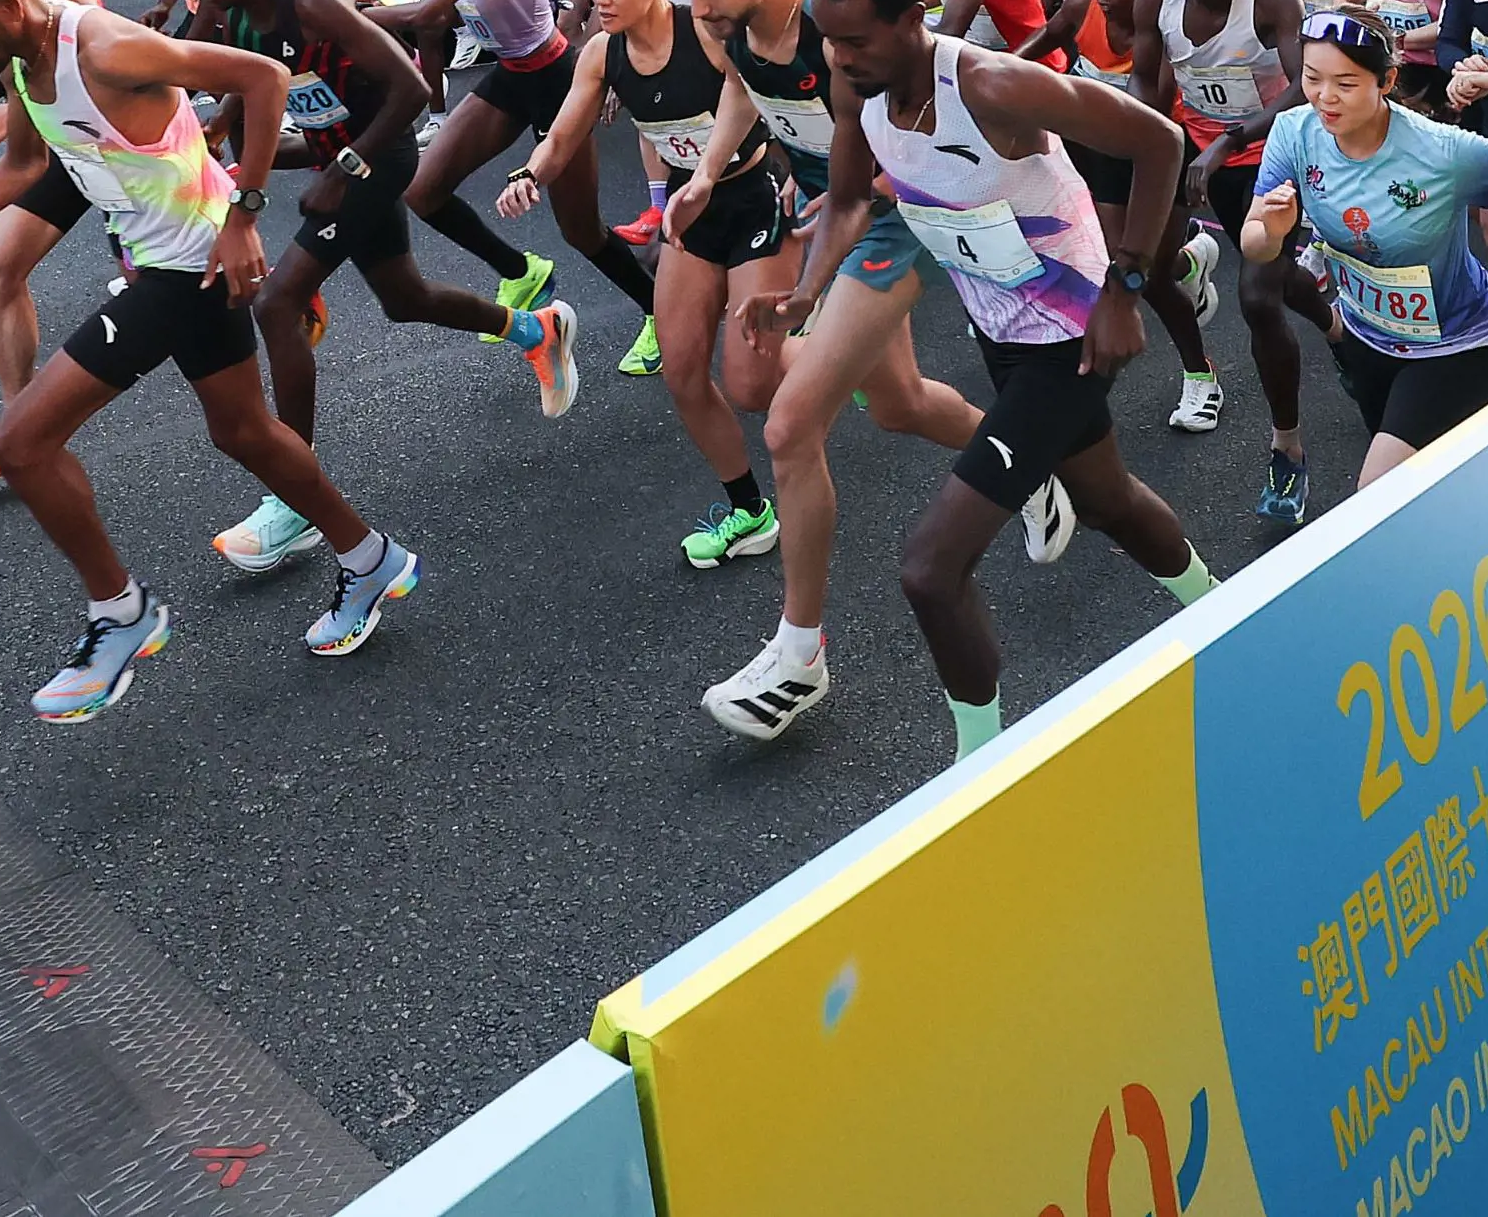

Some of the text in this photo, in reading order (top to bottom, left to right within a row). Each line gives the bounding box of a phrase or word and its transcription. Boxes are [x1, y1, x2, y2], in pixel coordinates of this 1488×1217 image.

[286, 86, 334, 114] 820
[1197, 83, 1228, 105] 10
[775, 115, 798, 137] 3
[669, 136, 702, 158] 61
[956, 235, 979, 264] 4
[1339, 264, 1430, 322] A7782
[1330, 986, 1450, 1172] MACAU
[1355, 1076, 1471, 1217] MACAO
